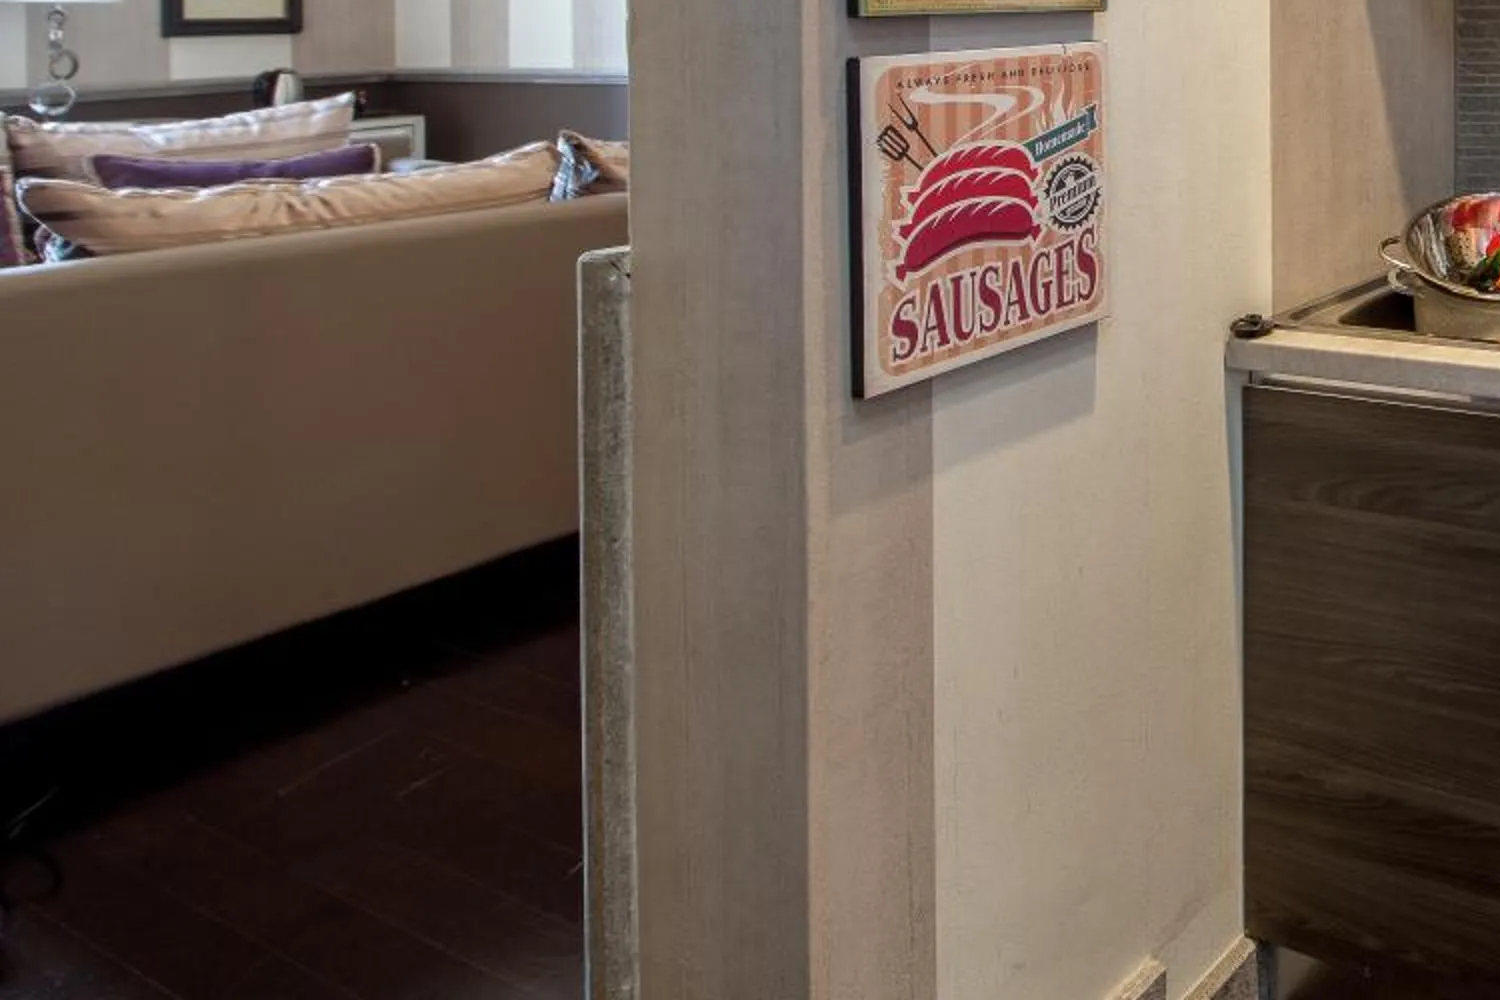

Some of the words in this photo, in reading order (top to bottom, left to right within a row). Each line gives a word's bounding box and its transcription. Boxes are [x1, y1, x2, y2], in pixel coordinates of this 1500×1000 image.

[895, 73, 951, 89] ALWAYS
[956, 71, 996, 84] FRESH
[1000, 68, 1025, 79] AND
[1049, 172, 1099, 214] Premium
[891, 224, 1098, 362] SAUSAGES
